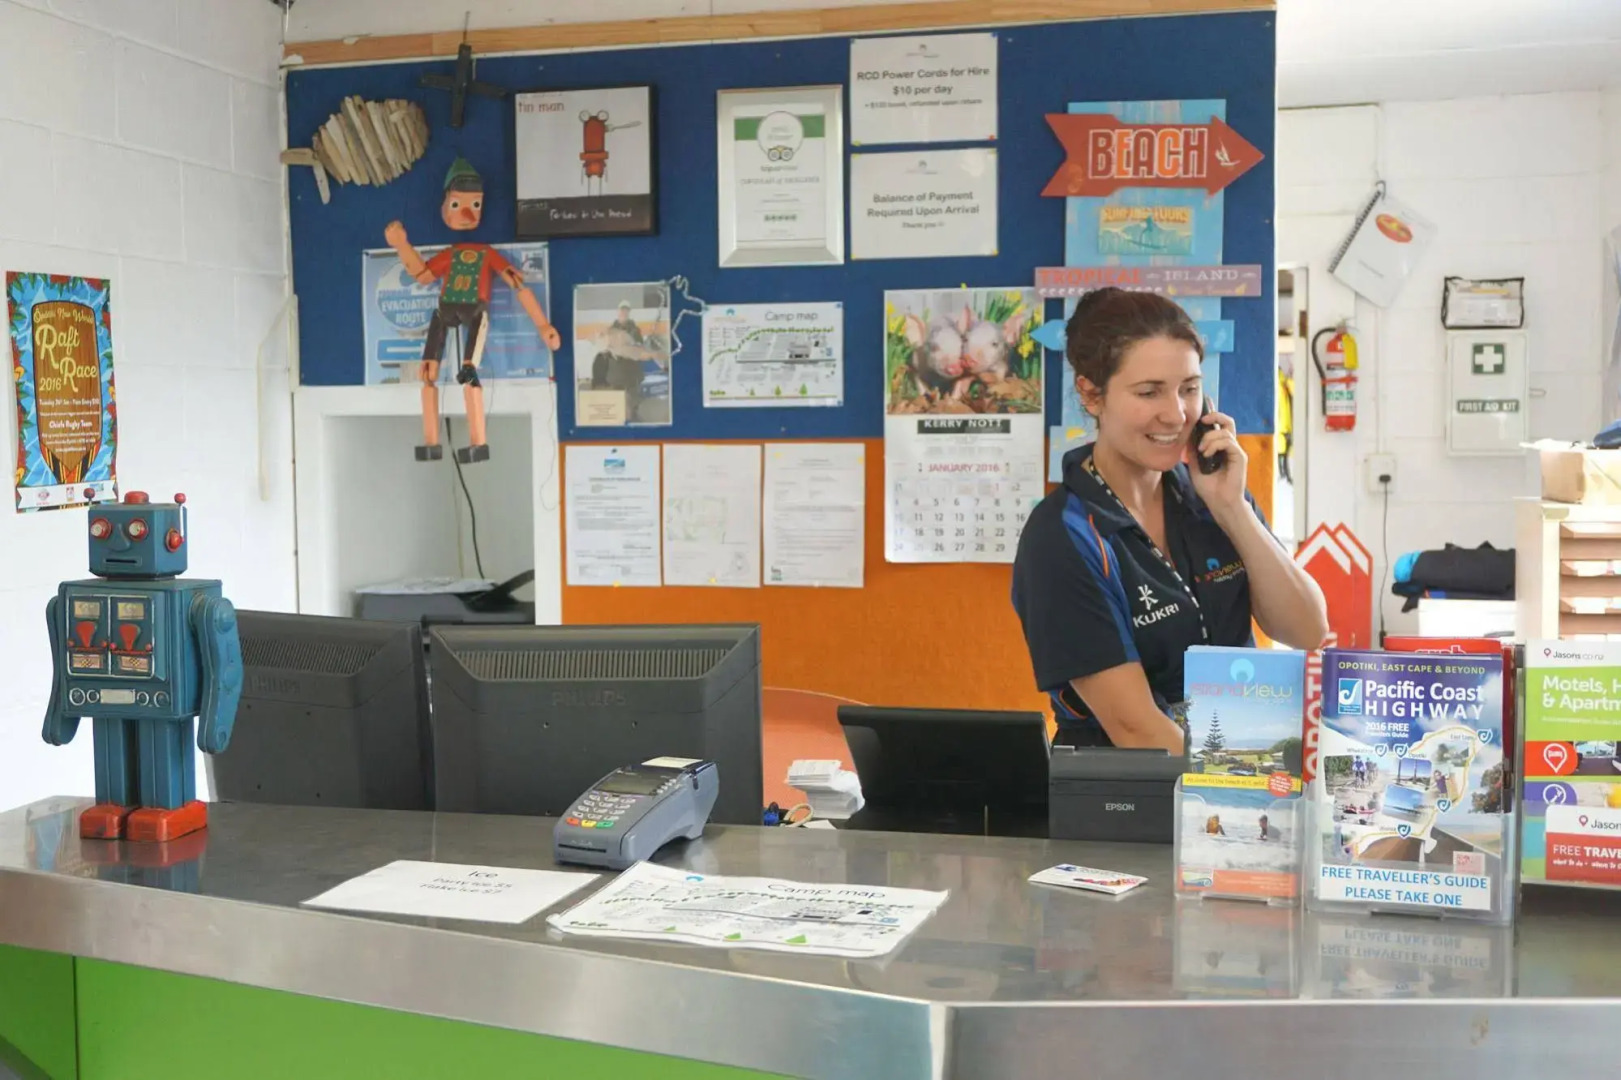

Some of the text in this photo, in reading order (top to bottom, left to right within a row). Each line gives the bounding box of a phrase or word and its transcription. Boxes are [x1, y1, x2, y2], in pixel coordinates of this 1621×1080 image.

[857, 71, 880, 81] RCD
[882, 69, 914, 80] Power
[951, 68, 965, 77] for
[968, 66, 990, 76] Hire
[892, 84, 954, 96] $10 per day
[1088, 128, 1208, 179] BEACH
[873, 192, 974, 203] Balance of Payment
[867, 205, 980, 218] Required Upon Arrival
[1038, 268, 1238, 286] TROPICAL ISLAND
[396, 312, 426, 324] ROUTE
[764, 312, 818, 322] Camp map
[35, 324, 80, 370] Raft
[60, 357, 98, 392] Race
[38, 378, 62, 392] 2016
[1459, 400, 1517, 412] FIRST AID KIT
[924, 418, 962, 428] KERRY
[928, 463, 1000, 472] JANUARY 2016
[934, 514, 944, 522] 12
[954, 514, 964, 522] 13
[974, 514, 985, 522] 14
[995, 514, 1004, 522] 15
[1016, 514, 1026, 522] 16
[954, 528, 965, 536] 20
[995, 528, 1005, 536] 22
[1132, 603, 1180, 628] KUKRI
[1338, 661, 1486, 675] OPOTIKI, EAST CAPE & BEYOND
[1365, 680, 1485, 702] Pacific Coast
[1543, 676, 1607, 694] Motels,
[1542, 693, 1556, 708] &
[1365, 700, 1484, 720] HIGHWAY
[1366, 722, 1410, 732] 2016 FREE
[1105, 802, 1135, 812] EPSON
[1552, 844, 1582, 856] FREE
[468, 870, 498, 878] Ice
[1322, 866, 1488, 890] FREE TRAVELLER'S GUIDE
[768, 884, 886, 898] Camp map
[1345, 886, 1462, 906] PLEASE TAKE ONE
